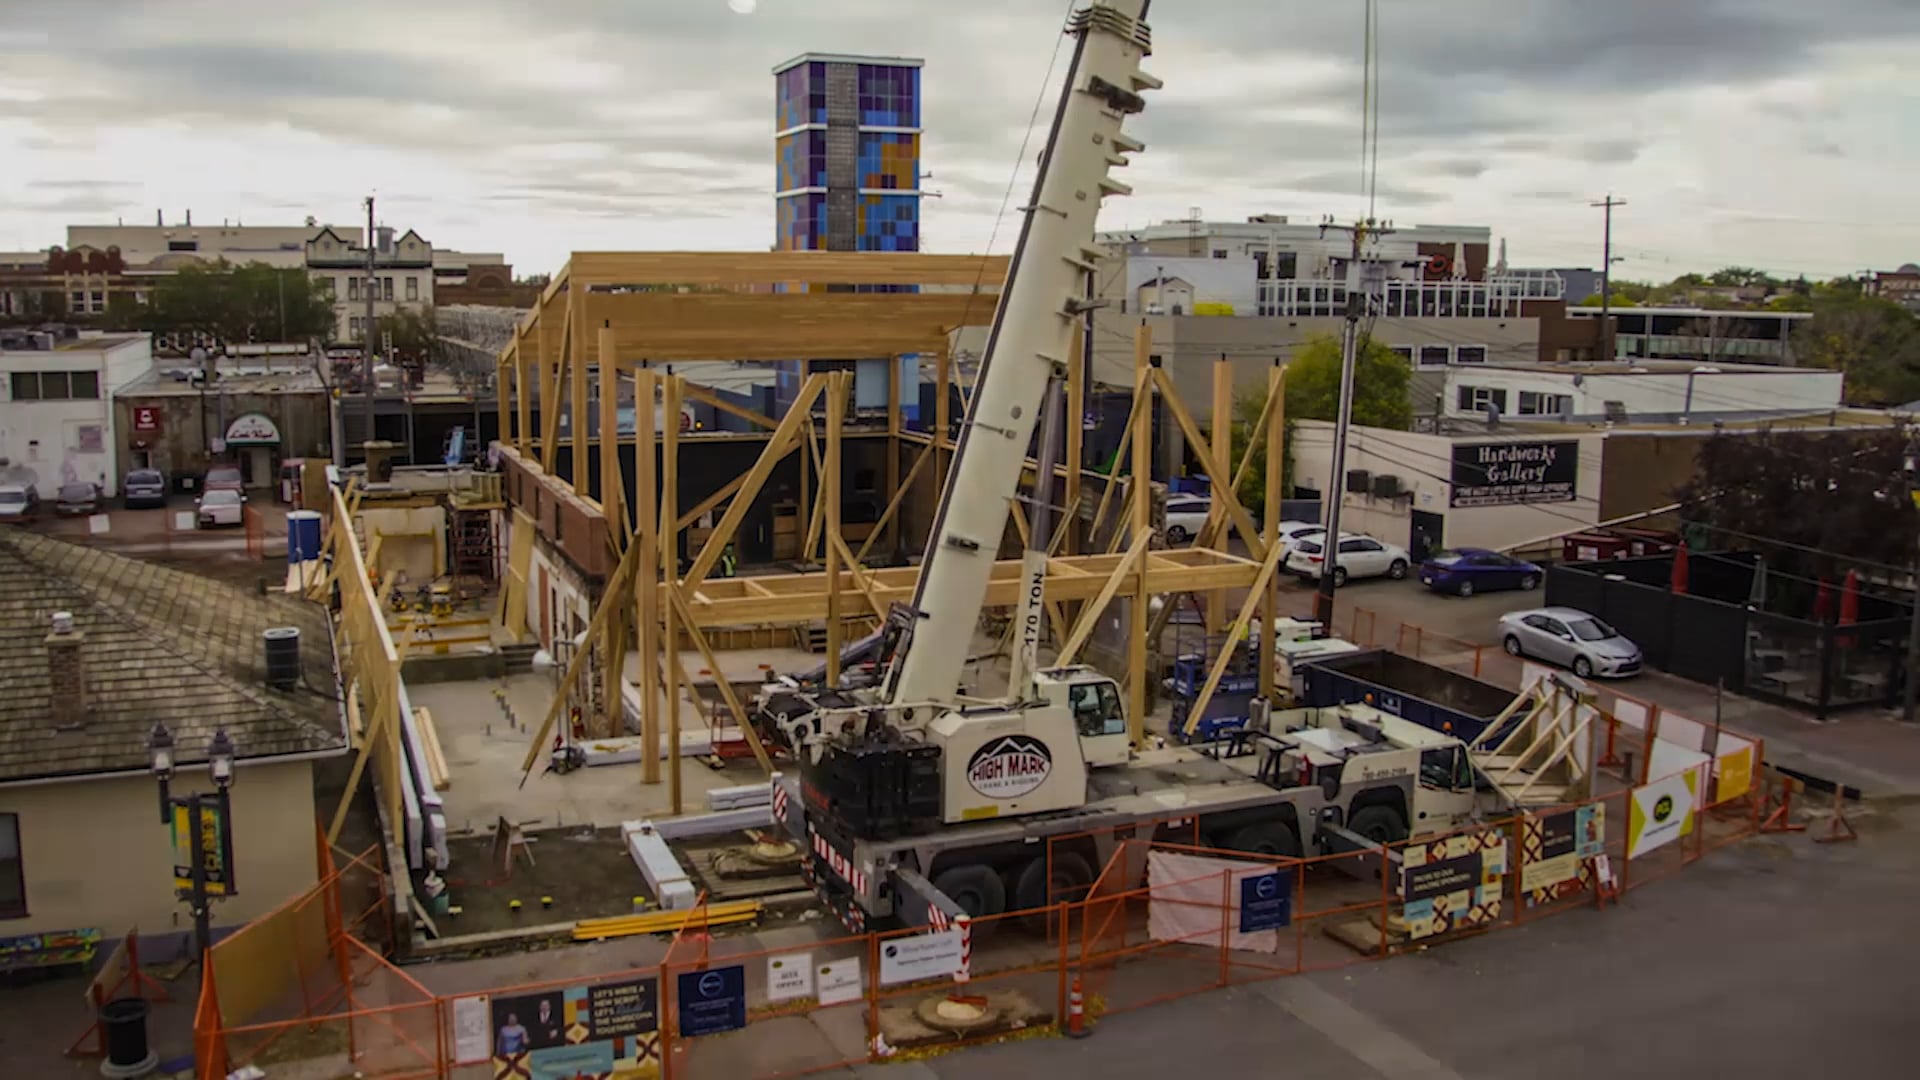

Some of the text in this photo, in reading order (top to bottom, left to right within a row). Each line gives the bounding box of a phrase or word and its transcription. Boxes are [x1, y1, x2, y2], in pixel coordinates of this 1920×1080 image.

[1478, 445, 1556, 466] Handworks
[1487, 463, 1547, 483] Gallery
[1024, 573, 1044, 646] 170 TON
[973, 754, 1045, 781] HIGH MARK
[639, 985, 645, 993] A
